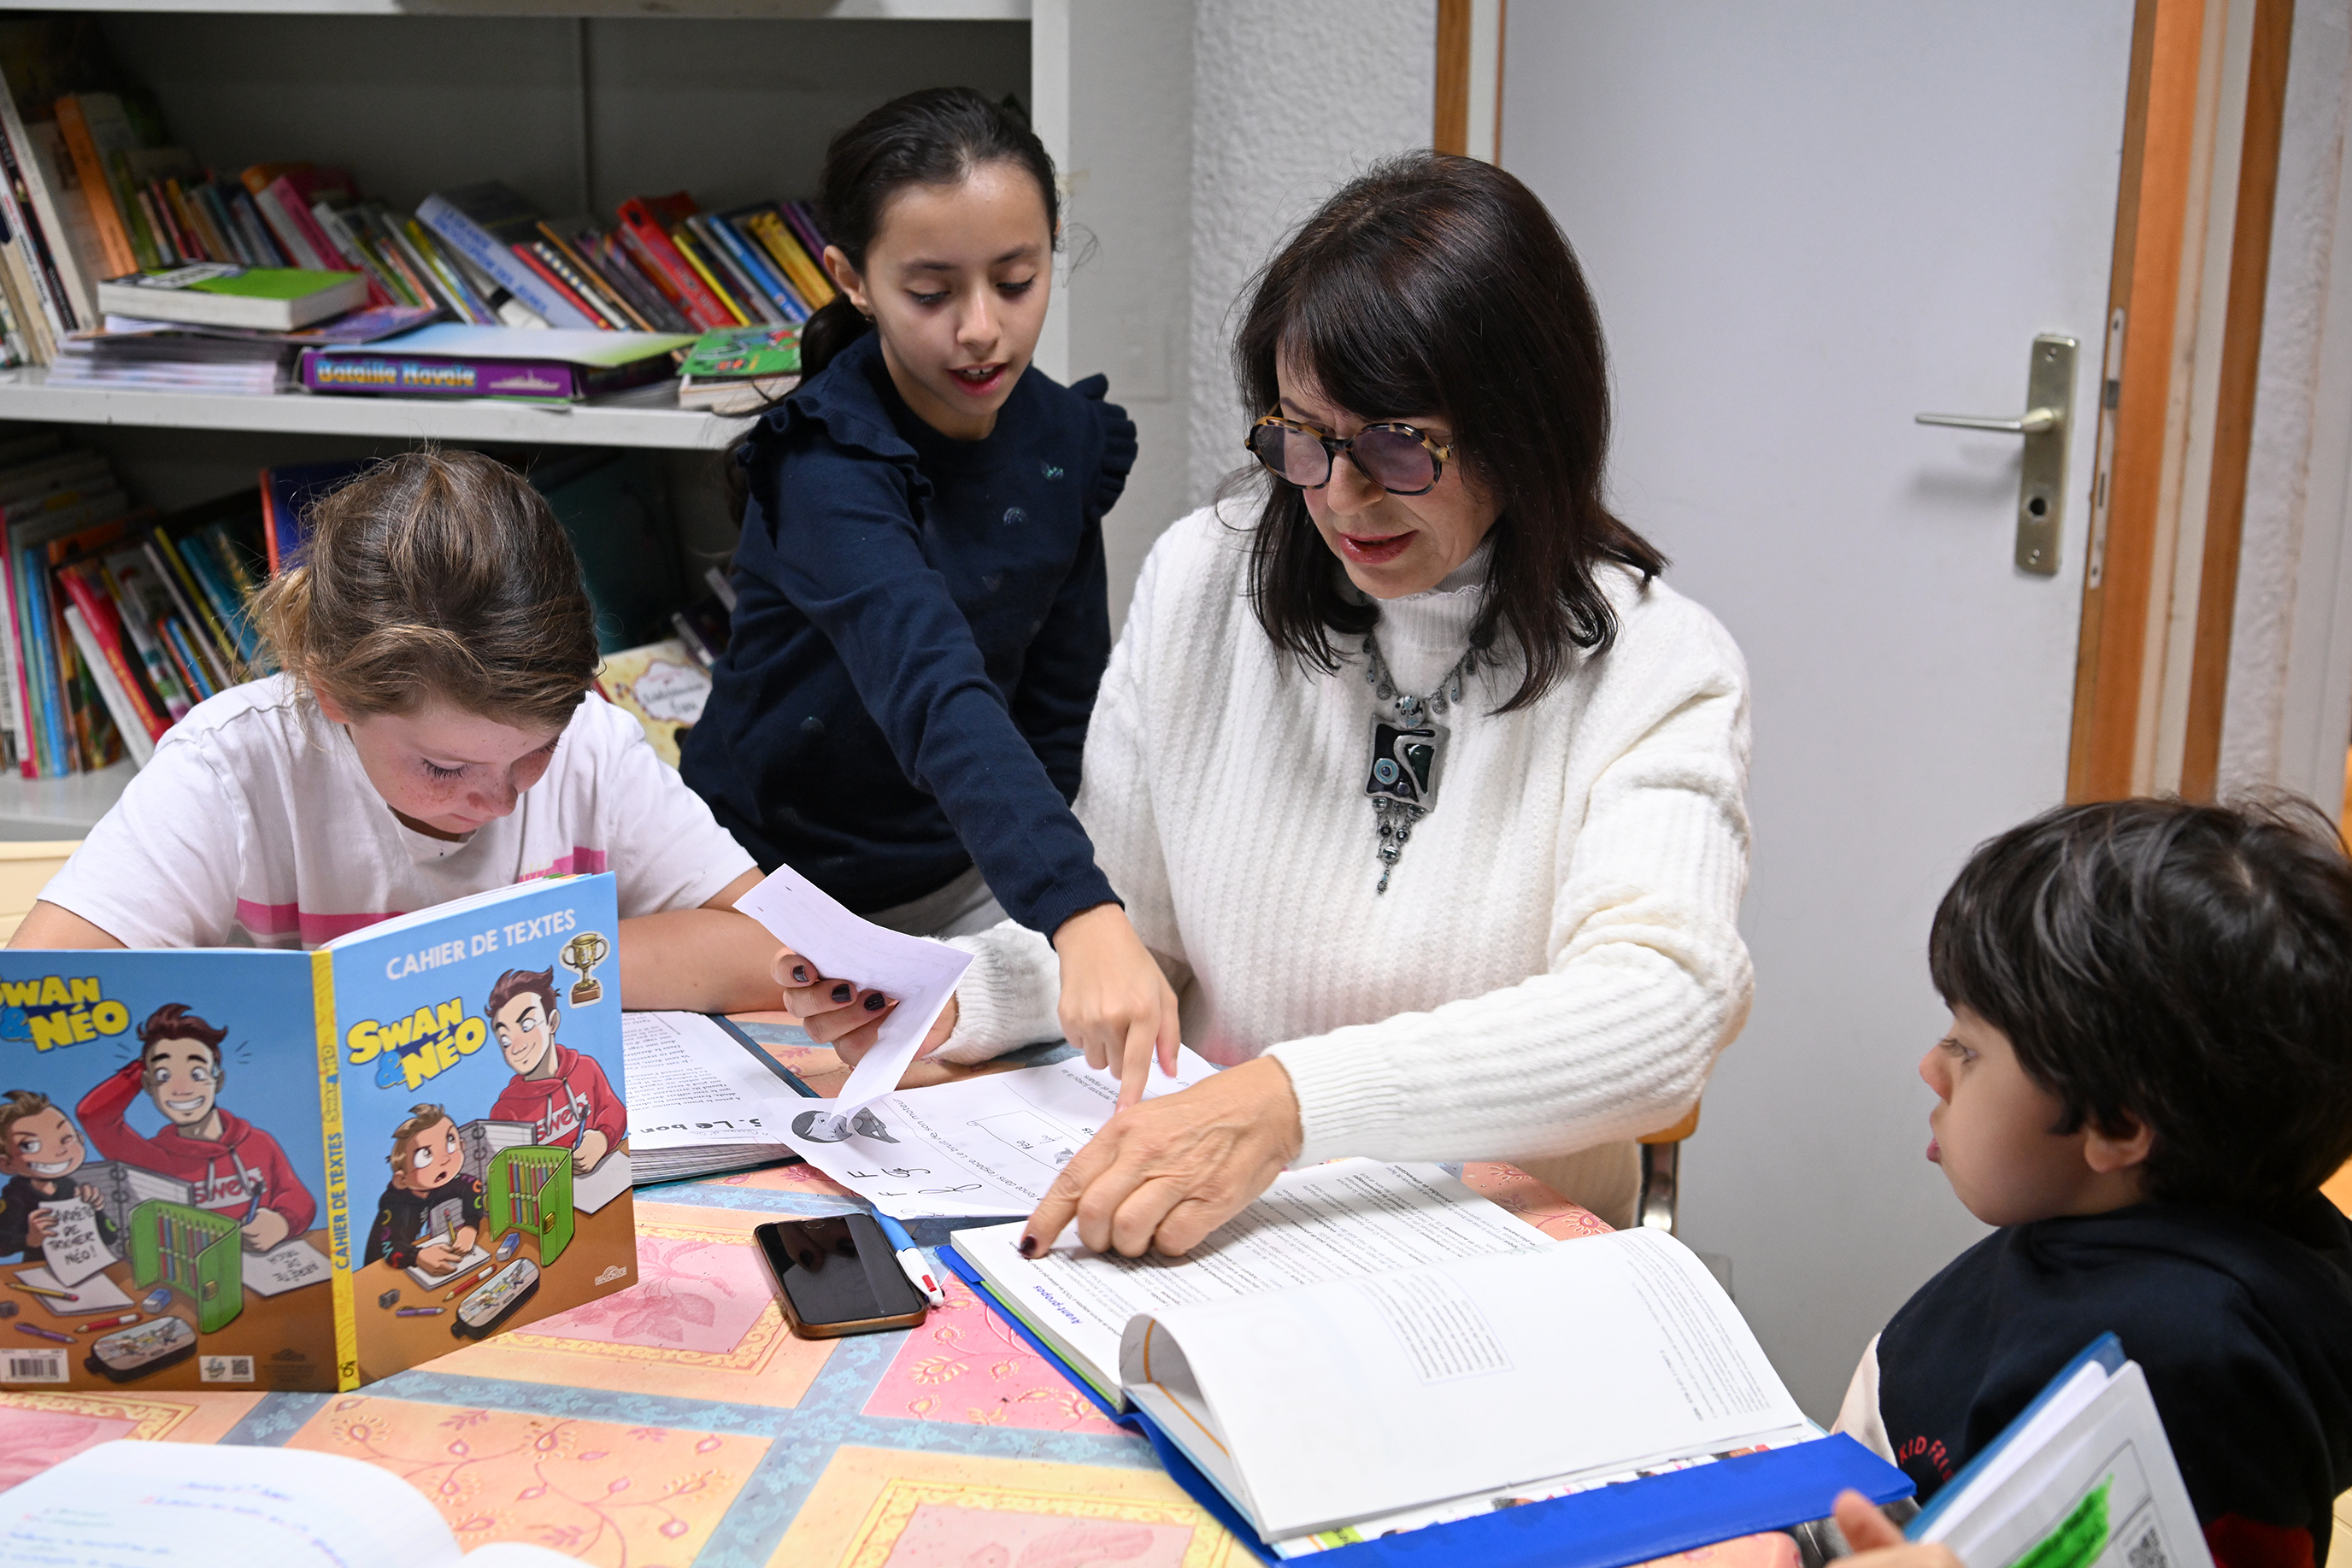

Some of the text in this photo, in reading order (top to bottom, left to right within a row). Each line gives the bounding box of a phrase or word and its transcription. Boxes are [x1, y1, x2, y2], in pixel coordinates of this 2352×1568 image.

[315, 358, 477, 388] Bataille Navale
[386, 908, 576, 981] CAHIER DE TEXTES
[0, 976, 101, 1009] WAN
[28, 1000, 131, 1053] NÉO
[346, 996, 464, 1065] SWAN
[375, 1015, 488, 1093] & NÉO
[893, 1098, 919, 1120] moteur
[640, 1123, 689, 1134] bon
[695, 1119, 735, 1130] Le
[917, 1120, 933, 1134] son
[938, 1137, 960, 1154] bruit
[956, 1150, 968, 1159] Le
[1015, 1139, 1034, 1150] fée
[998, 1176, 1017, 1189] dans
[1349, 1173, 1385, 1195] apprentissages
[1390, 1164, 1426, 1184] différenciation
[326, 1130, 350, 1271] CAHIER DE TEXTES
[1014, 1185, 1038, 1198] fonce
[1424, 1186, 1455, 1203] photofiches
[62, 1224, 81, 1236] DE
[1309, 1217, 1339, 1233] vocabulaire
[46, 1231, 95, 1251] TRICHER
[1028, 1284, 1084, 1324] Avant-propos
[1061, 1289, 1077, 1299] TOUS
[1898, 1436, 1927, 1465] KID
